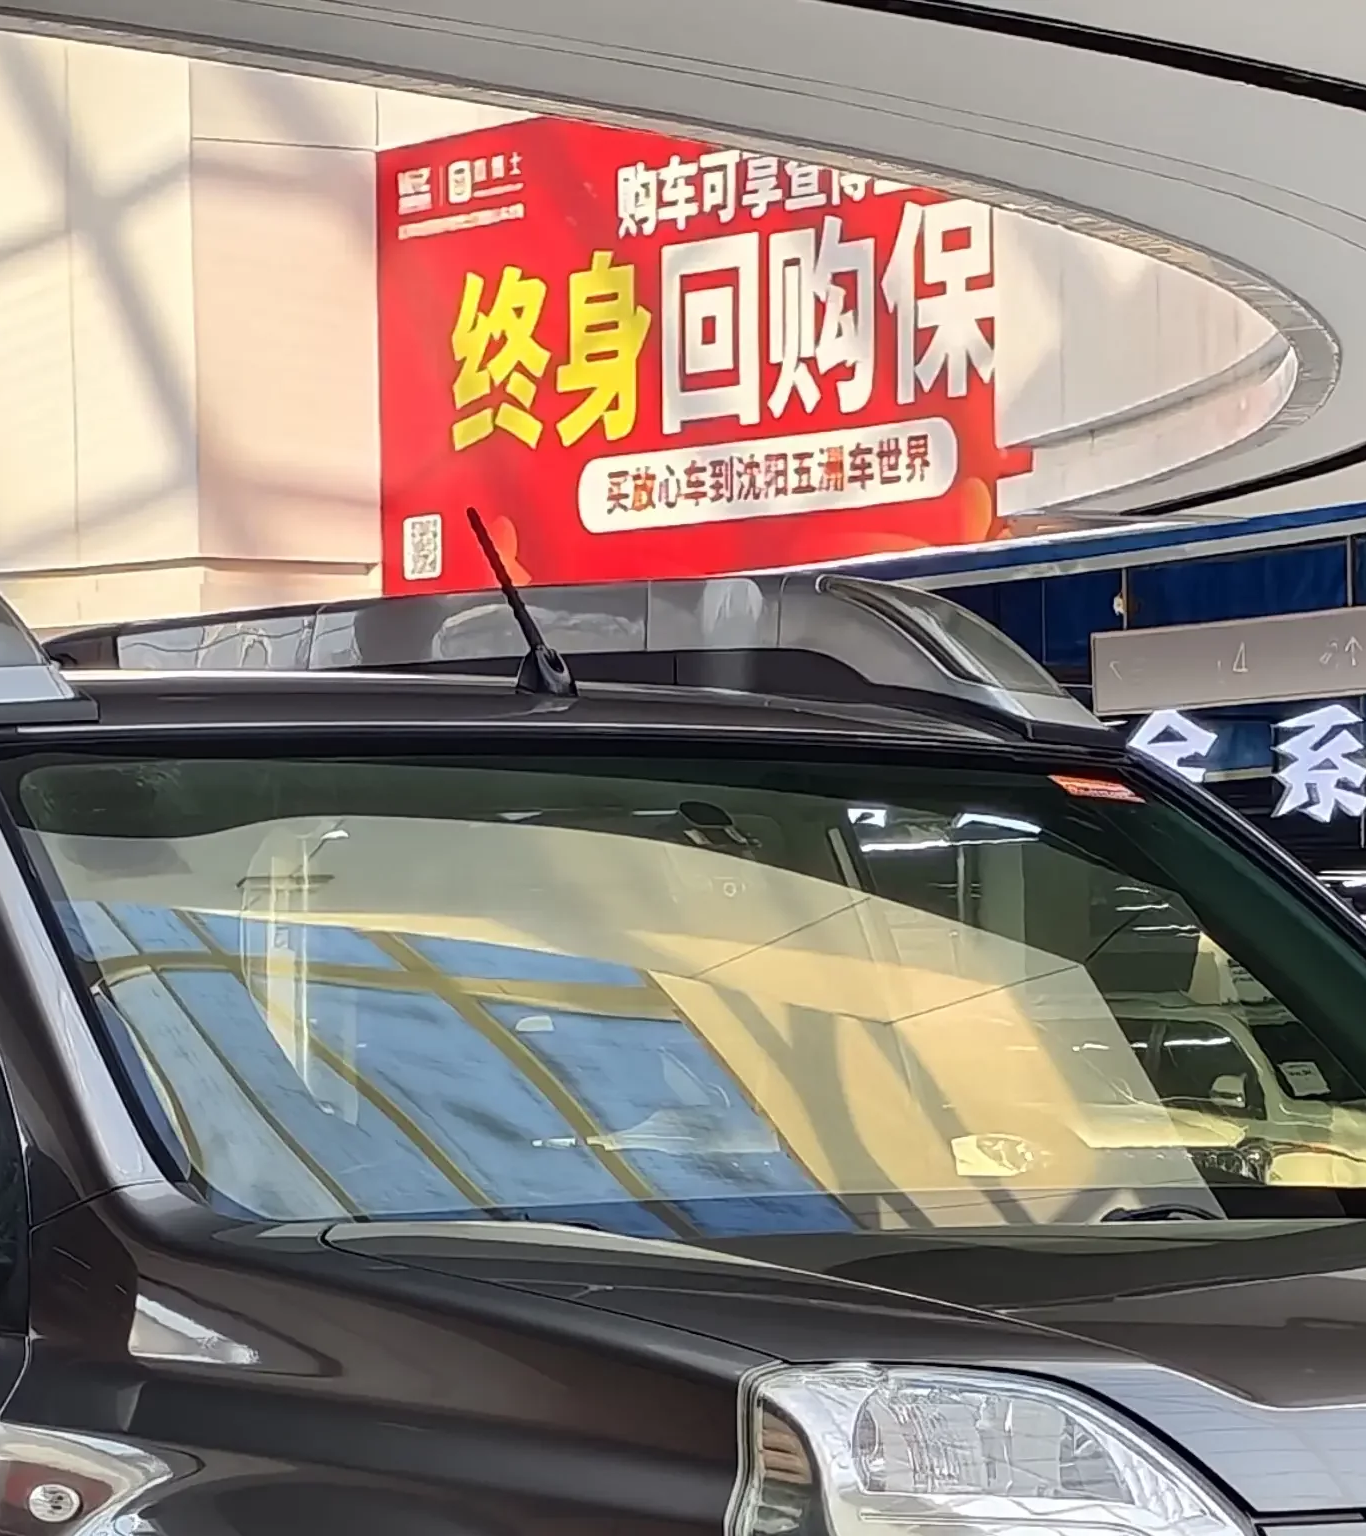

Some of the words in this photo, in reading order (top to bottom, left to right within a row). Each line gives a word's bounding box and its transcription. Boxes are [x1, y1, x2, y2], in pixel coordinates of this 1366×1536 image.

[452, 200, 996, 450] 终身回购保
[606, 433, 932, 515] 买放心车到沈阳五洲车世界
